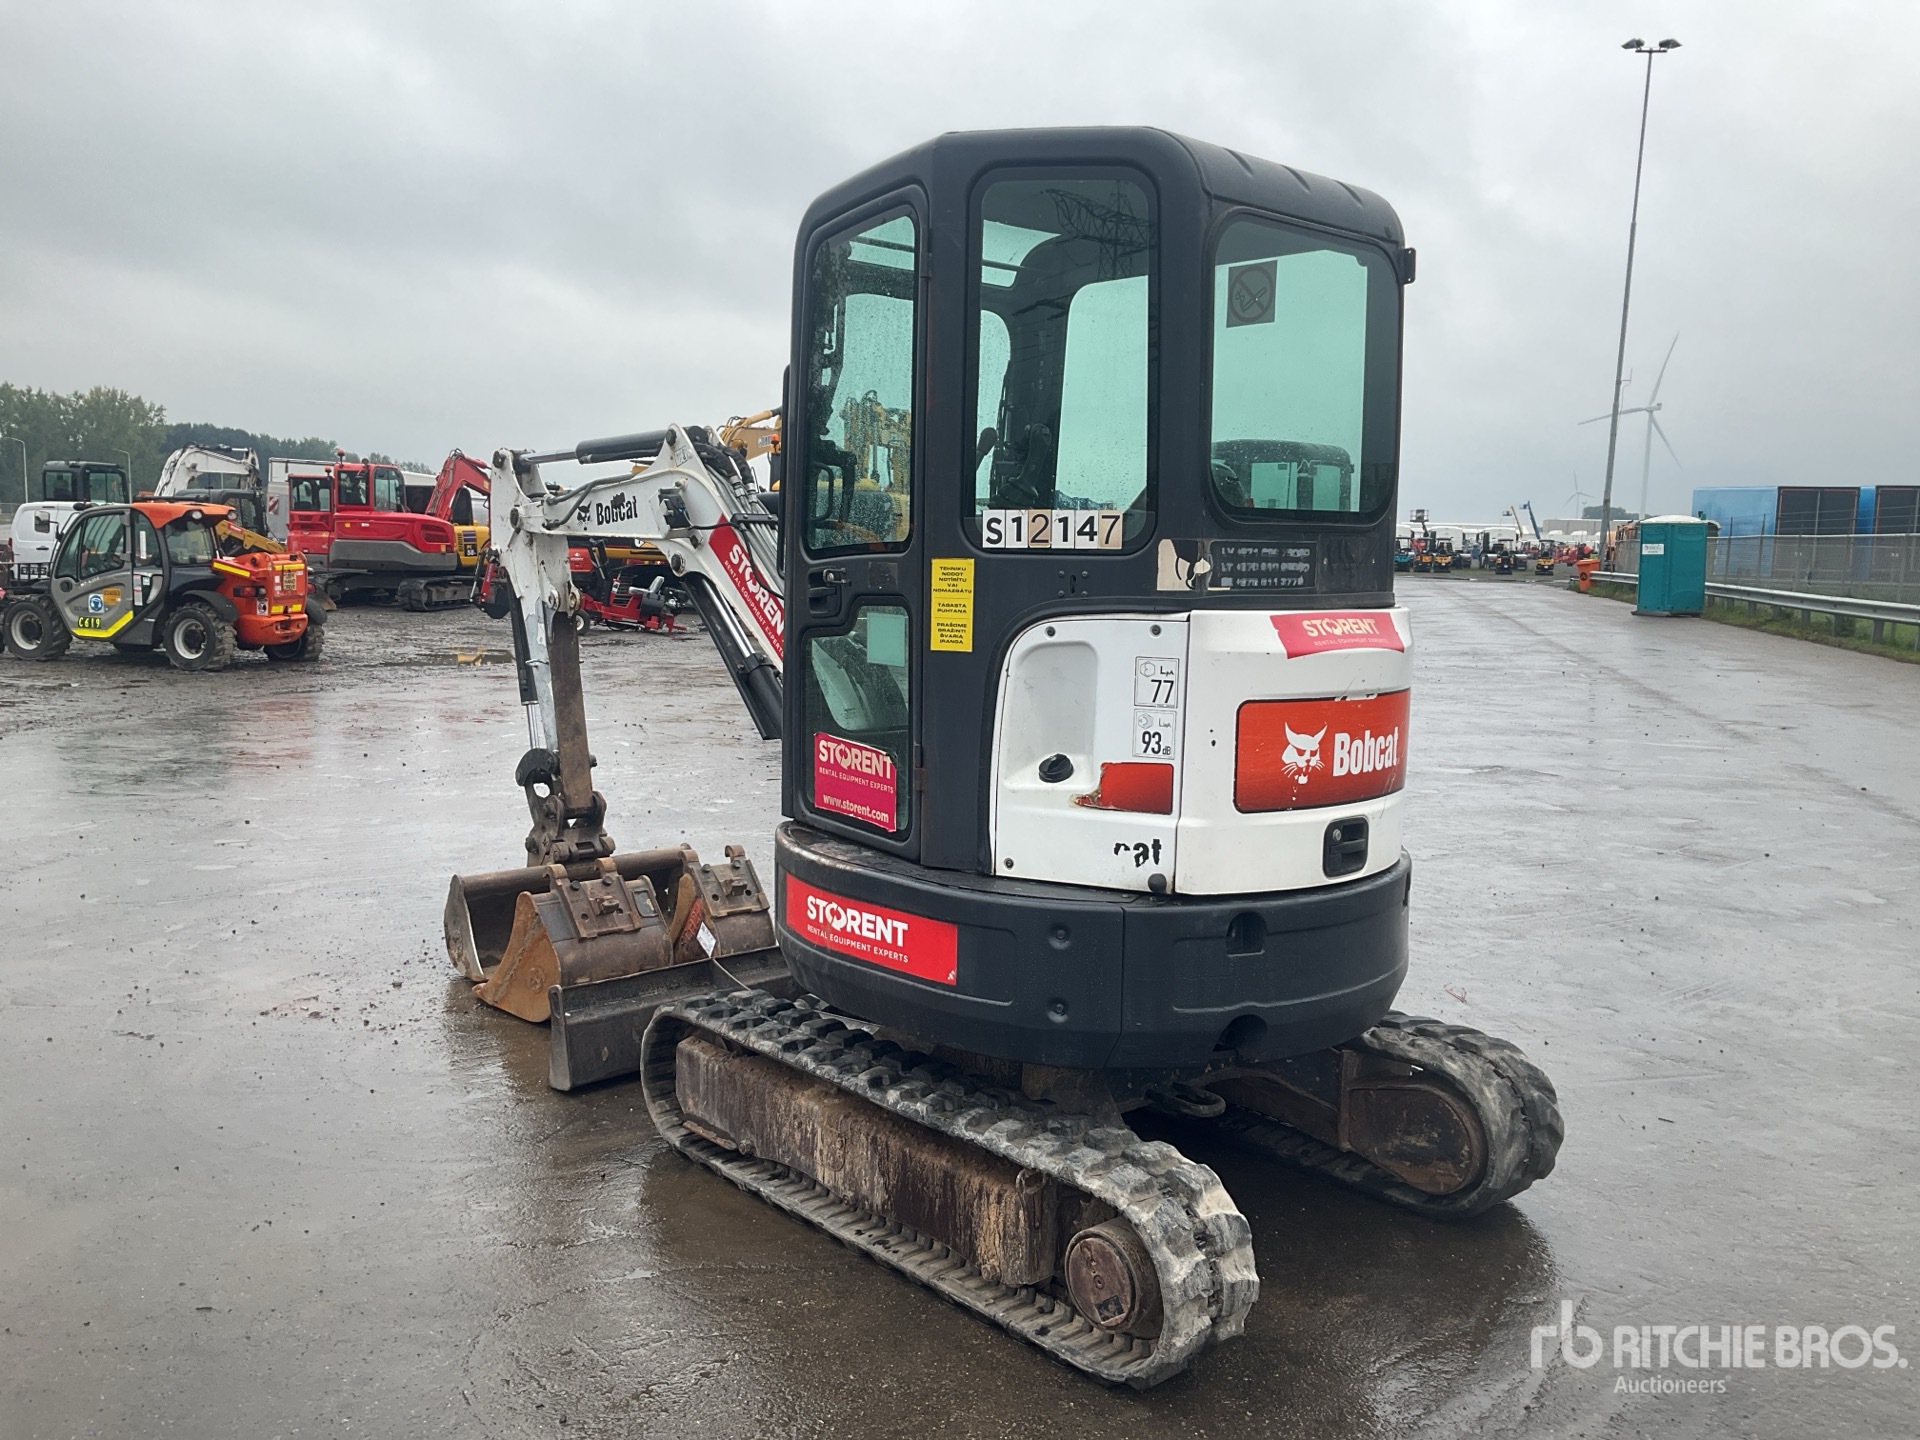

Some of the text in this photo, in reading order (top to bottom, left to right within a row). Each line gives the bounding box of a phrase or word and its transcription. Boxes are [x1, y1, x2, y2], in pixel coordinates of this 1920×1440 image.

[985, 513, 1121, 546] S12147
[724, 560, 741, 588] RENTAL
[740, 587, 767, 627] EQUIPMENT
[729, 543, 785, 637] STOREN
[1302, 617, 1380, 637] STORENT
[1150, 679, 1175, 704] 77
[818, 739, 893, 779] STORENT
[1141, 730, 1162, 755] 93
[1332, 726, 1399, 777] Bobcat
[819, 766, 894, 794] RENTAL EQUIPMENT EXPERTS
[822, 794, 889, 823] www.storent.com
[807, 894, 909, 948] STORENT
[807, 923, 909, 963] RENTAL EQUIPMENT EXPERTS
